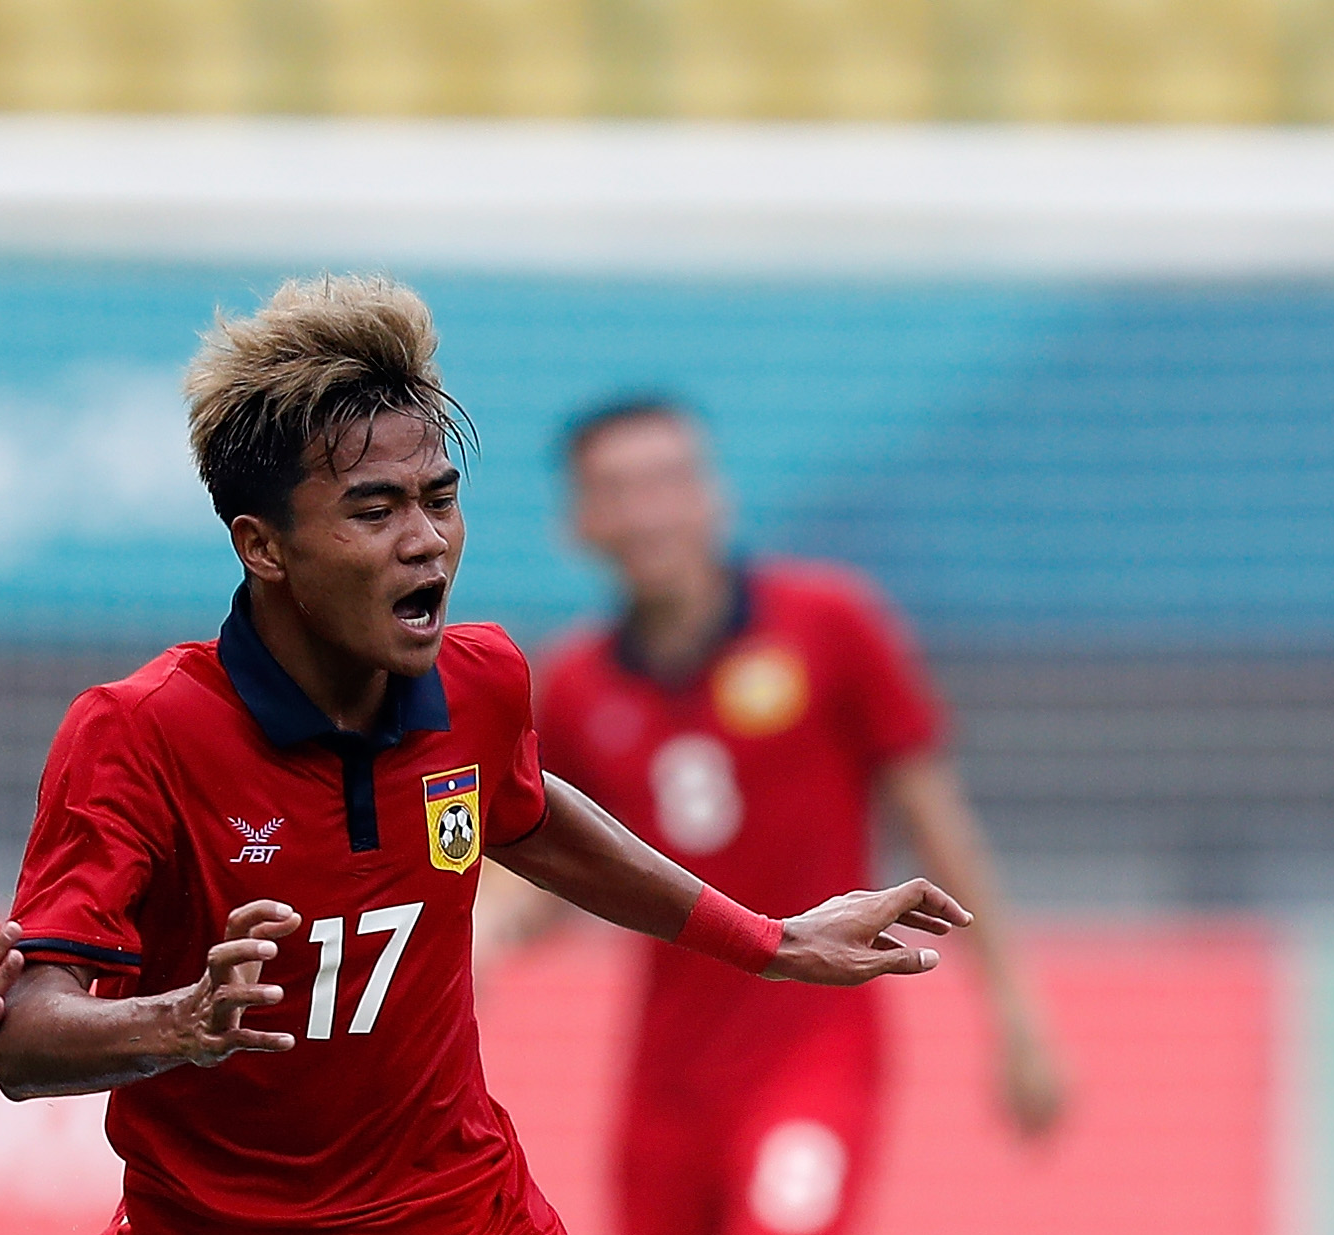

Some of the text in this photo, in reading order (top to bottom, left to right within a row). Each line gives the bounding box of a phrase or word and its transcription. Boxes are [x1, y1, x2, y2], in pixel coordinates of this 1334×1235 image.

[652, 737, 744, 853] 8
[229, 845, 282, 864] FBT
[307, 901, 425, 1040] 17
